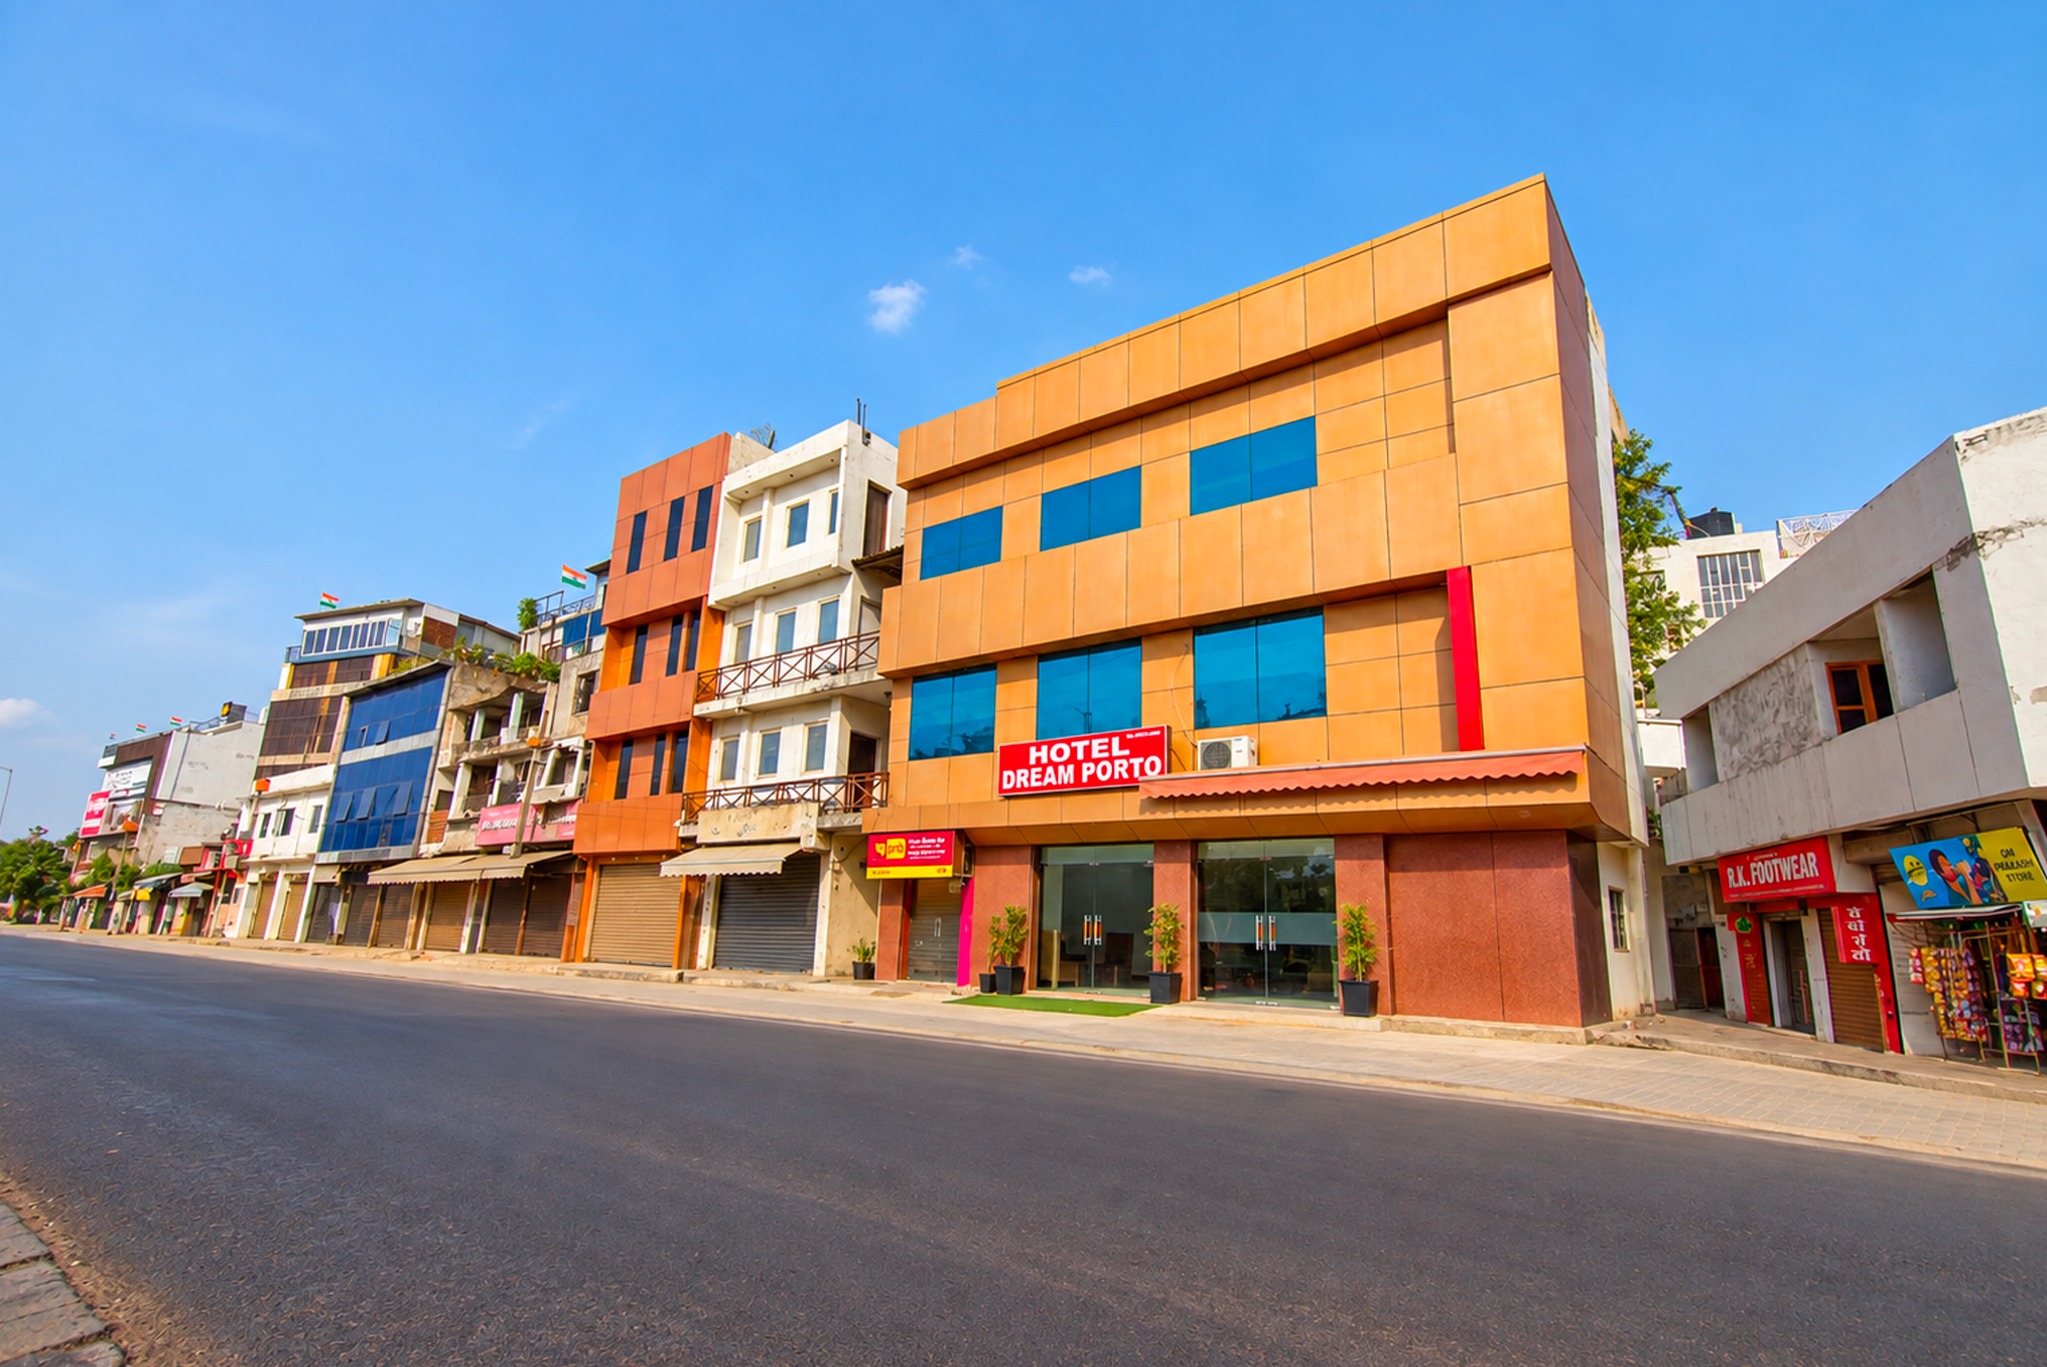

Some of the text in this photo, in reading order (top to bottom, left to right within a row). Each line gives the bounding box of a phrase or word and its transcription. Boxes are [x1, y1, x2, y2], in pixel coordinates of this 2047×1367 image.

[1029, 736, 1130, 765] HOTEL
[1002, 755, 1162, 790] DREAM PORTO
[1727, 852, 1819, 889] R.K. FOOTWEAR
